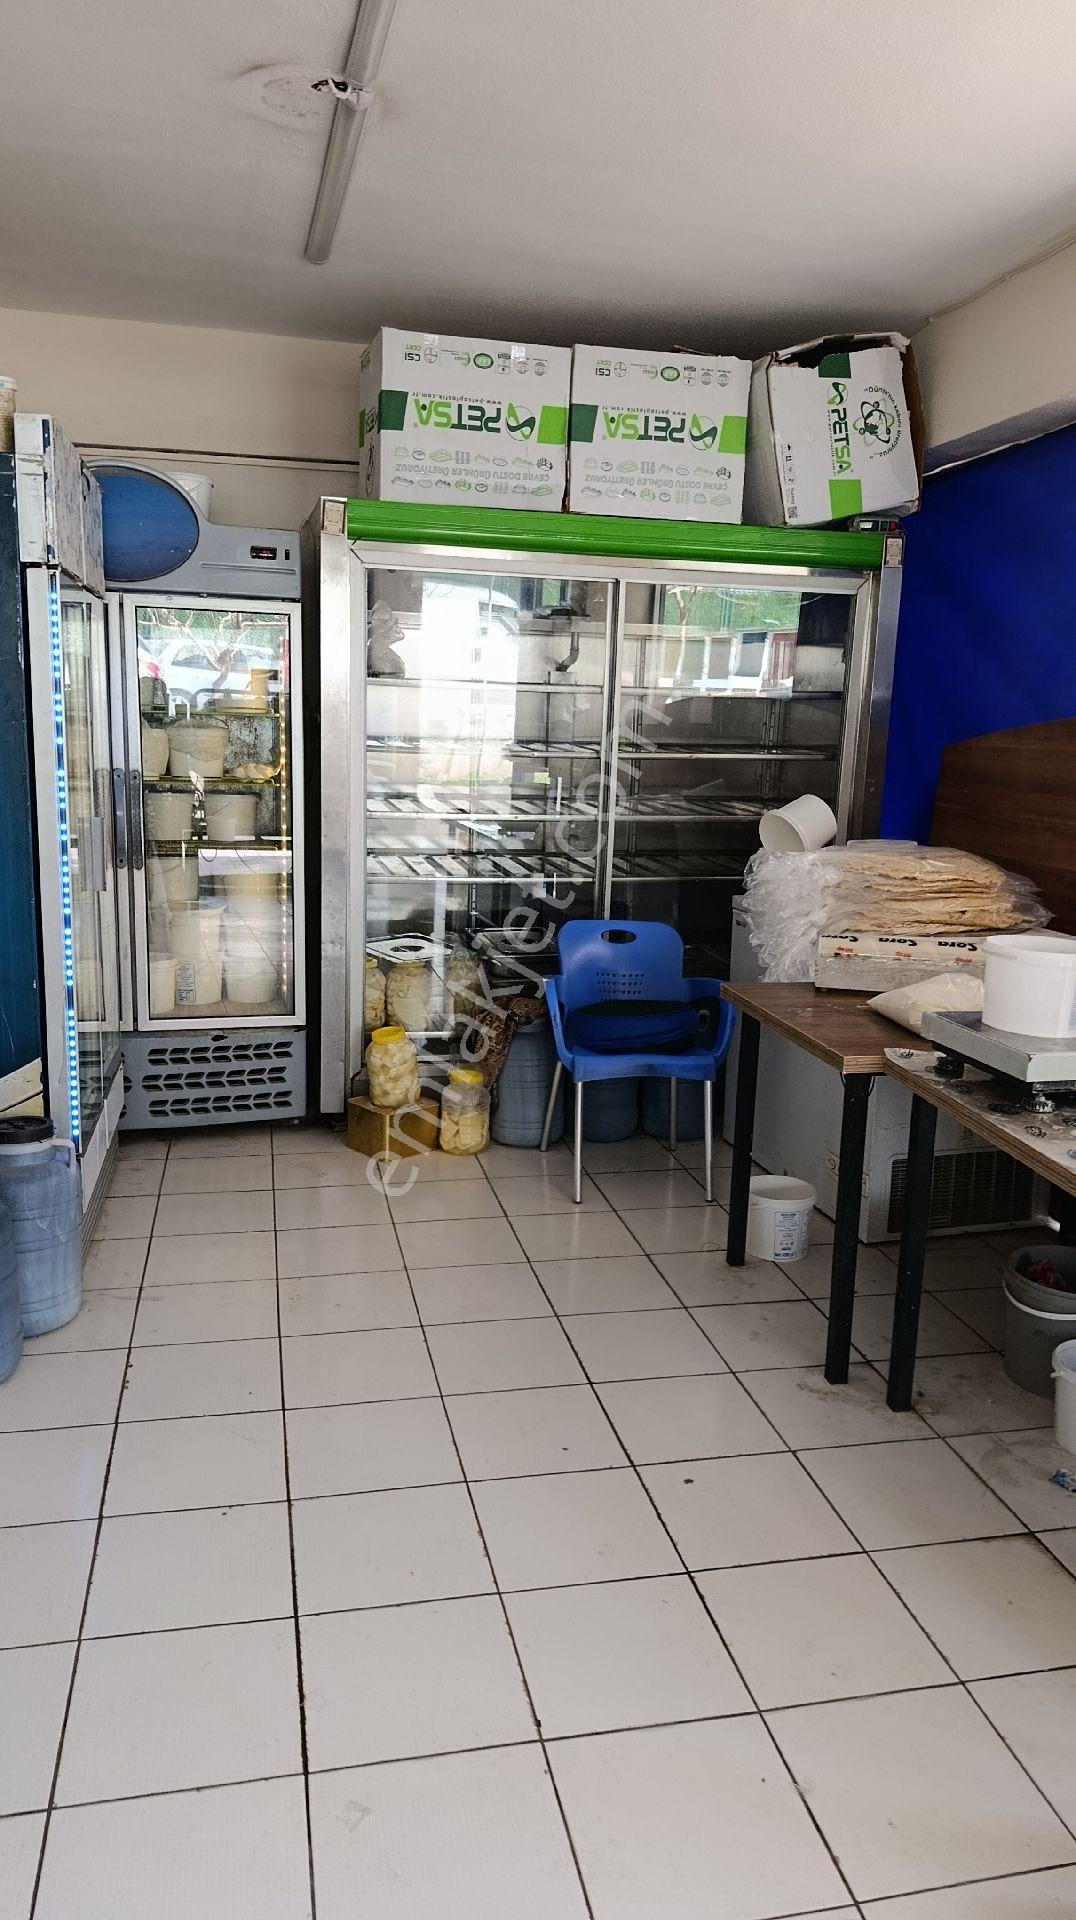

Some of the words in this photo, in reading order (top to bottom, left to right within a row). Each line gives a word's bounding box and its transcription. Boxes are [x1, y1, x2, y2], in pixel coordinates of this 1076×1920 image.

[404, 352, 421, 361] CSI
[595, 367, 611, 376] CSI
[412, 391, 502, 404] www.petsaplastik.com.tr
[414, 398, 502, 434] PETSA
[603, 411, 687, 444] PETSA
[831, 407, 852, 474] PETSA
[492, 470, 523, 481] DOSTU
